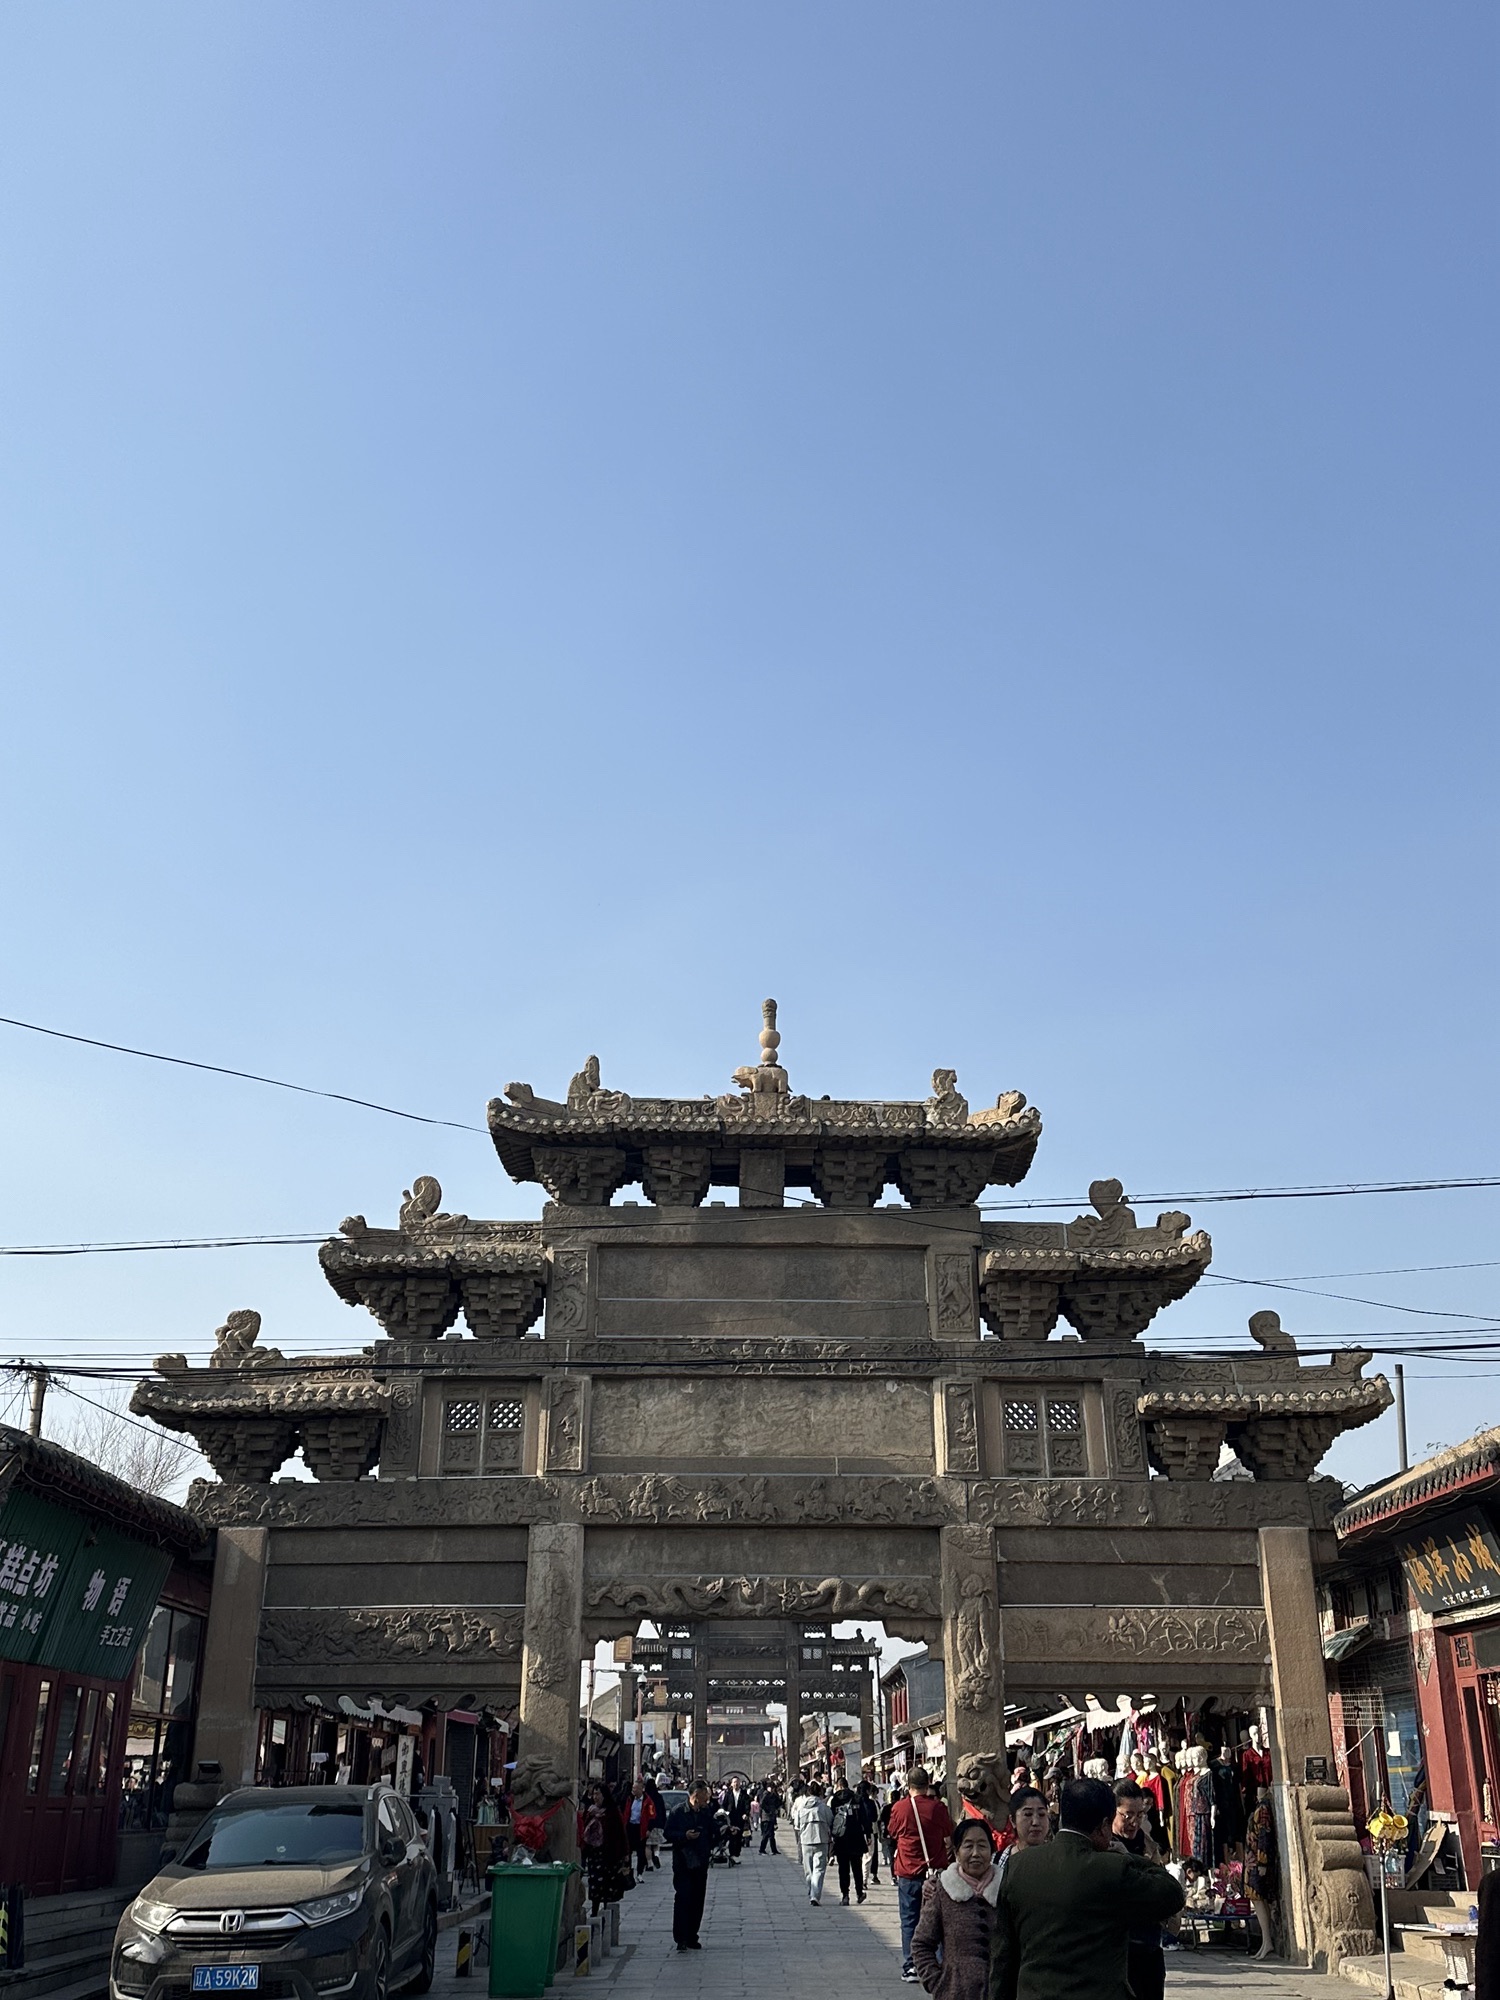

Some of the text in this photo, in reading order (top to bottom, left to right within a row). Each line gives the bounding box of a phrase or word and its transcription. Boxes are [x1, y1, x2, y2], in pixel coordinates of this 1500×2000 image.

[20, 1608, 43, 1635] 小吃
[99, 1624, 134, 1647] 手工艺品
